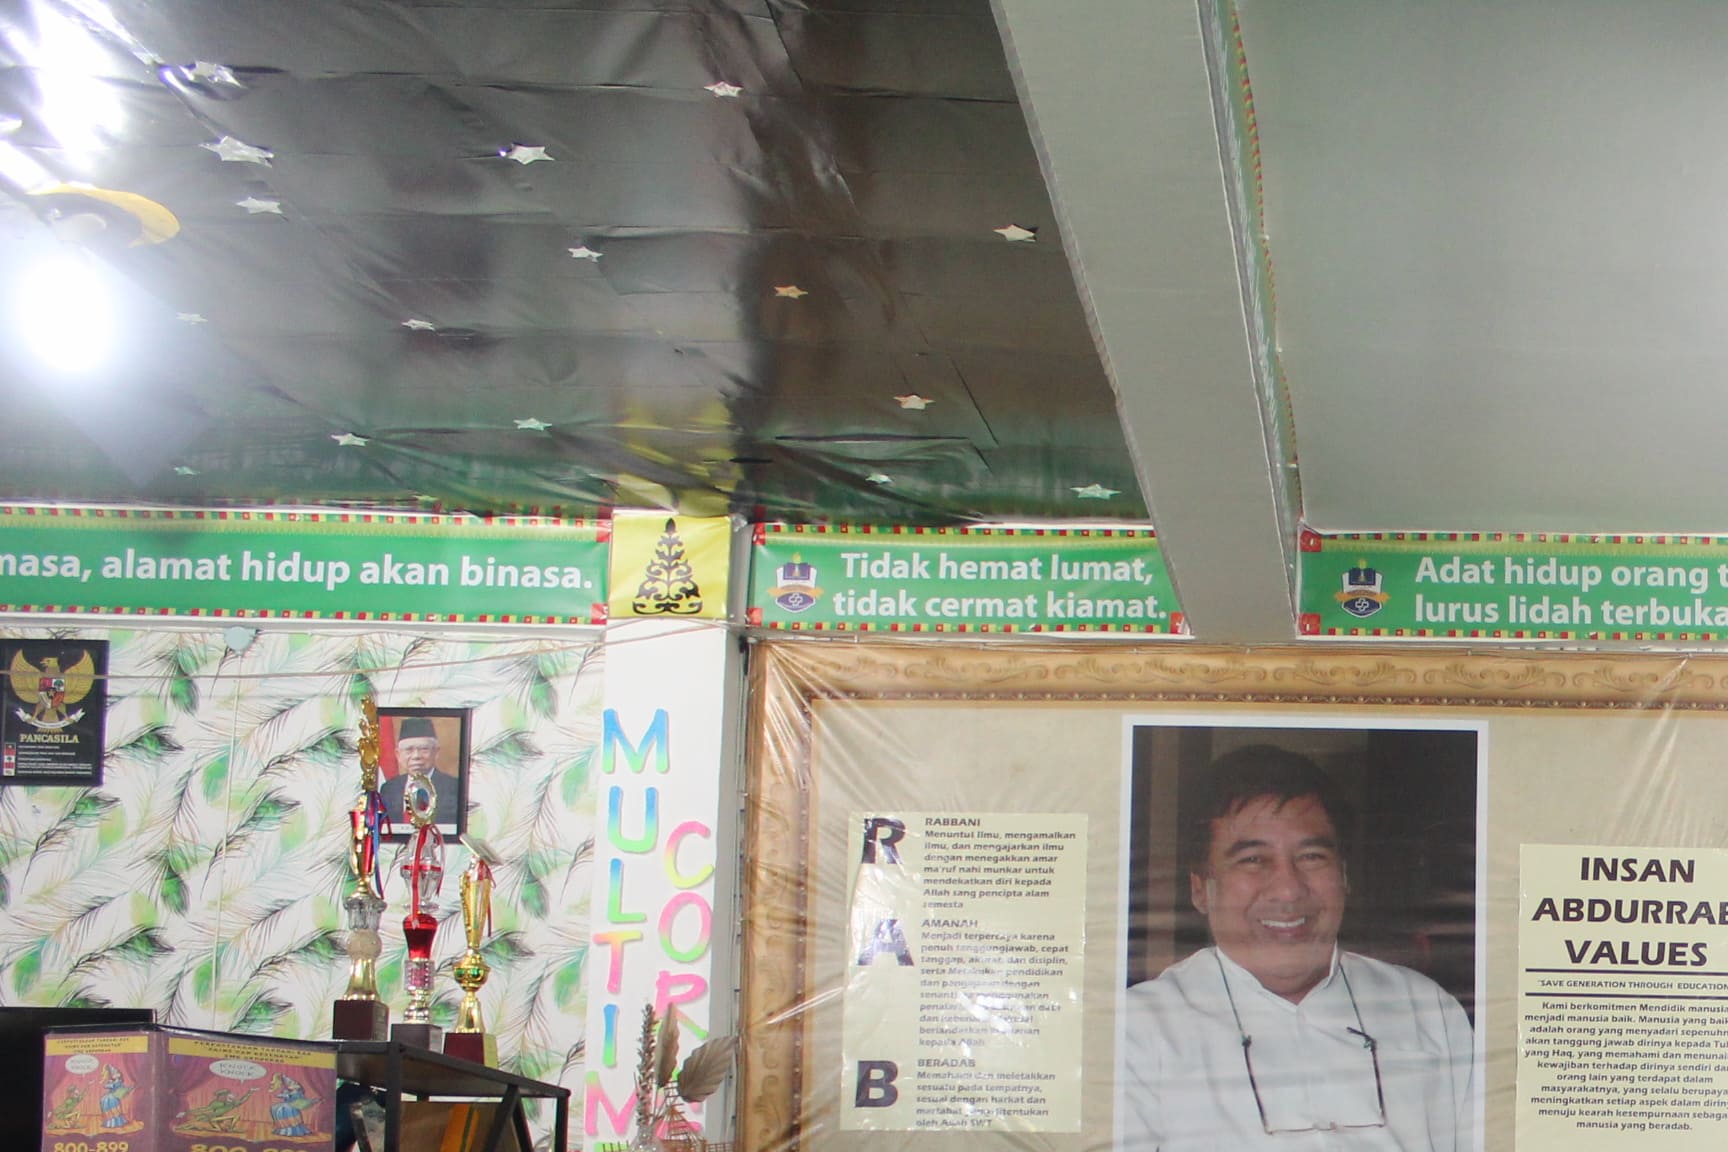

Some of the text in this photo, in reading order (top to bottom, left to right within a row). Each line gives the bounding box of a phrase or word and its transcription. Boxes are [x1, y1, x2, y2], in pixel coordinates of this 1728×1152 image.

[103, 548, 231, 583] alamat
[241, 552, 350, 590] hidup
[360, 553, 448, 586] akan
[460, 555, 592, 589] binasa.
[841, 553, 1152, 587] Tidak hemat lumat,
[1415, 557, 1494, 585] Adat
[1504, 557, 1601, 591] hidup
[1611, 564, 1709, 594] orang
[833, 591, 1166, 619] tidak cermat kiamat.
[1415, 595, 1499, 622] lurus
[1508, 596, 1591, 624] lidah
[19, 734, 79, 743] PANCASILA
[862, 818, 981, 864] R RABBANI
[1580, 857, 1695, 883] INSAN
[921, 919, 978, 928] AMANAH
[1565, 940, 1708, 966] VALUES
[1524, 1013, 1565, 1024] menjadi
[1567, 1014, 1609, 1022] manusia
[1611, 1015, 1636, 1023] baik.
[1638, 1015, 1680, 1024] Manusia
[1682, 1018, 1707, 1026] yang
[1541, 1002, 1568, 1010] Kami
[1569, 1002, 1637, 1011] berkomitmen
[1639, 1003, 1686, 1012] Mendidik
[854, 1060, 899, 1108] B
[917, 1059, 976, 1068] BERADAB
